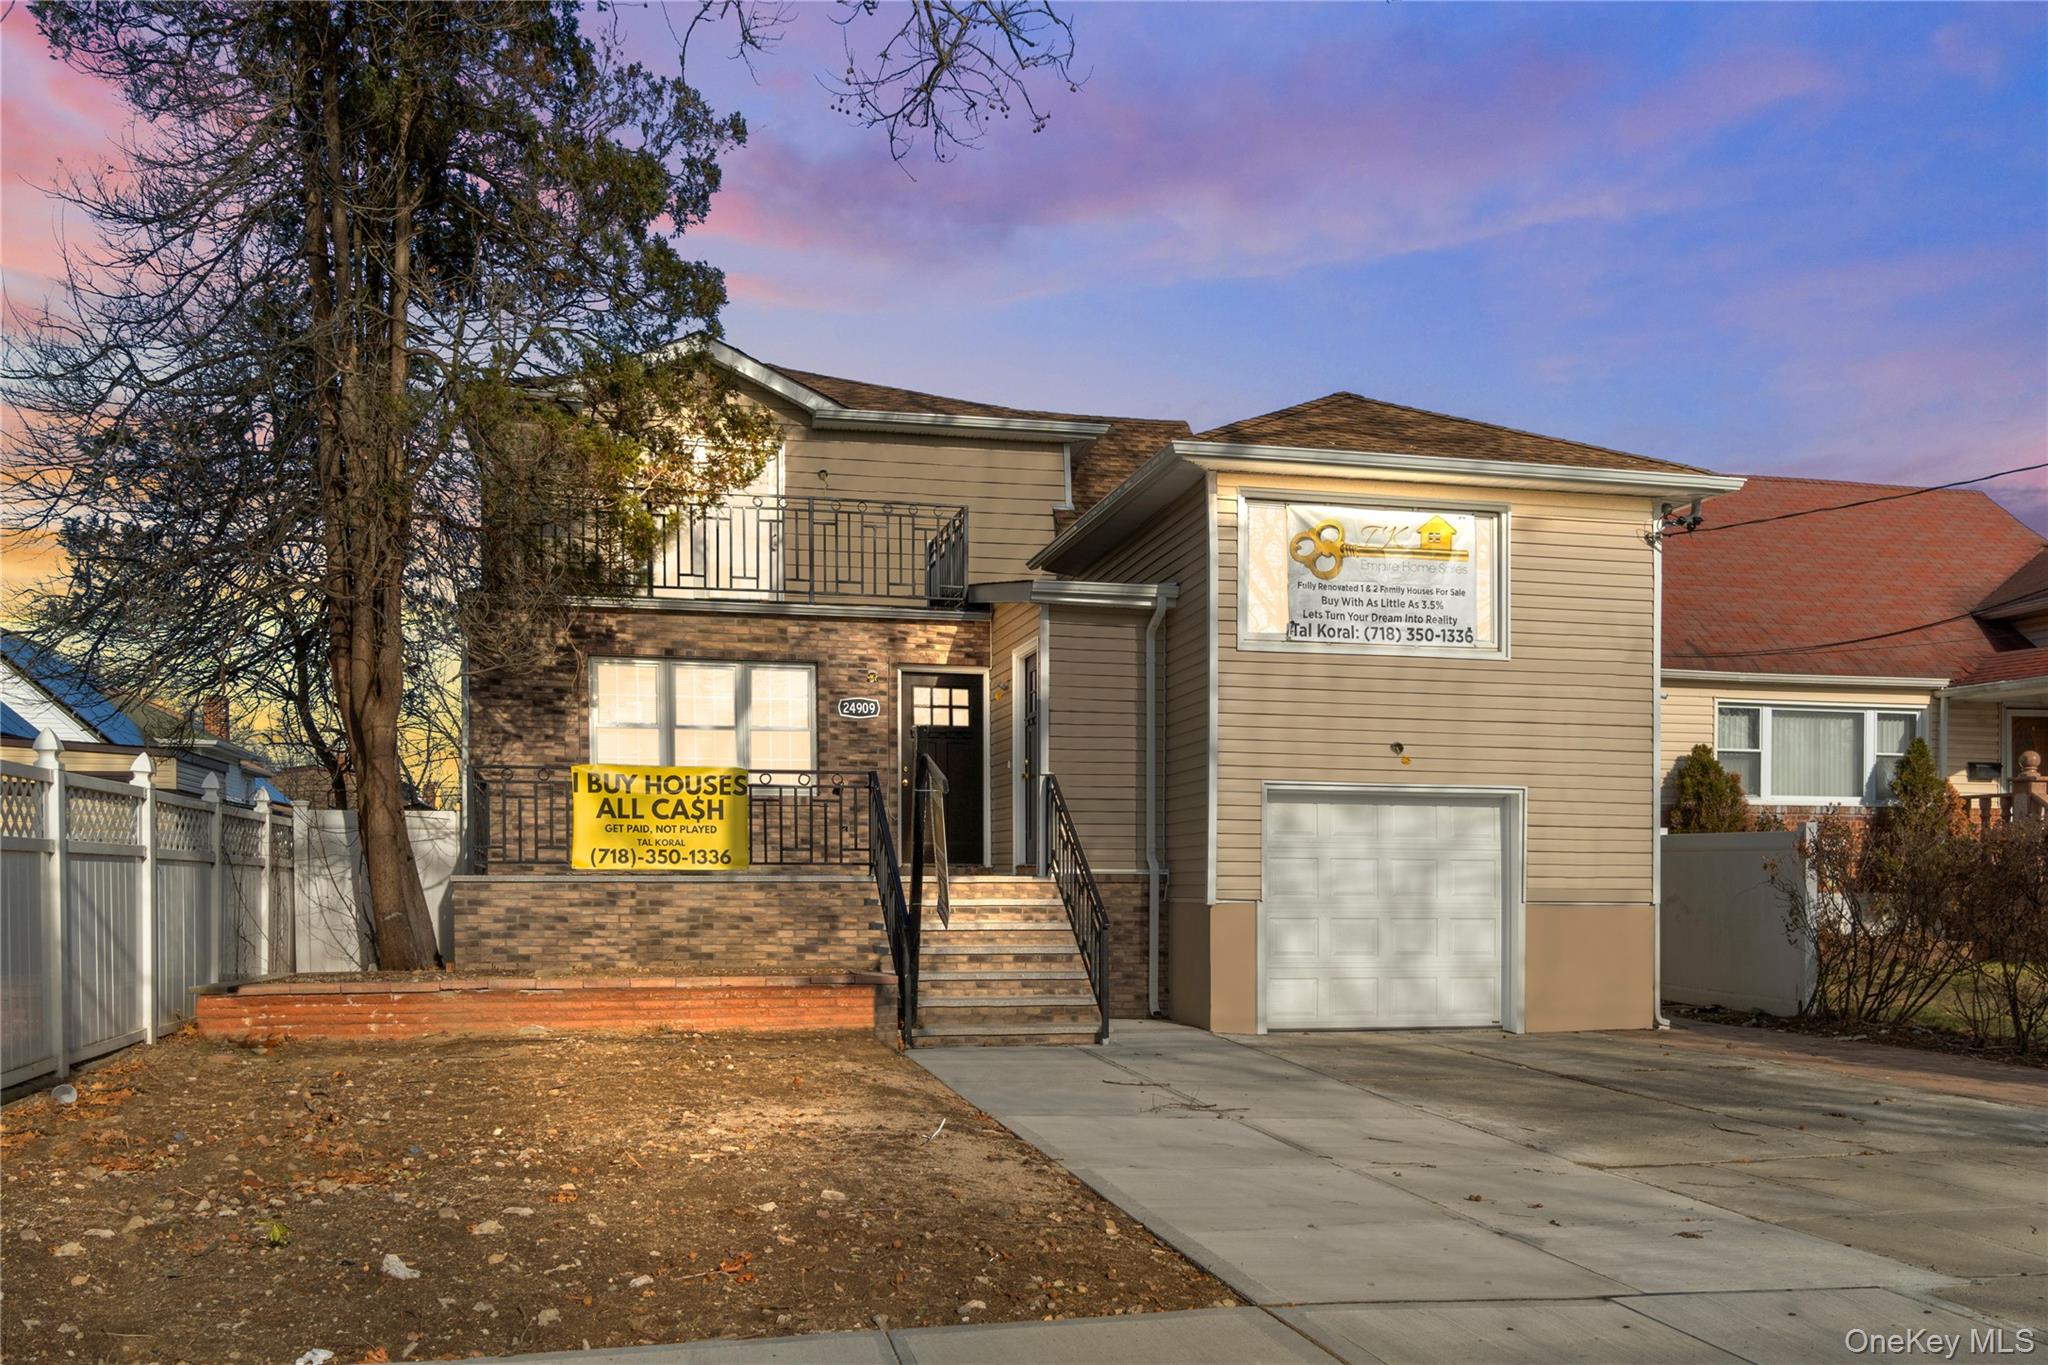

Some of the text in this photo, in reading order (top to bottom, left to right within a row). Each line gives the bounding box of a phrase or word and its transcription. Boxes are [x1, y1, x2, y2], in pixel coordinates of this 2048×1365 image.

[1361, 560, 1400, 573] Empire
[1402, 561, 1437, 573] Home
[1297, 581, 1316, 591] Fully
[1318, 583, 1359, 592] Renovated
[1380, 585, 1405, 595] Family
[1406, 587, 1434, 595] Houses
[1450, 588, 1466, 596] Sale
[1321, 595, 1444, 609] Buy With As Little As 3.5%
[1302, 609, 1458, 626] Lets Turn Your Dream Into Reality
[1293, 622, 1474, 643] Tal Koral: (718) 350-1336
[843, 702, 876, 714] 24909
[573, 772, 747, 796] I BUY HOUSES
[596, 796, 724, 823] ALL CA$H
[605, 824, 717, 834] GET PAID, NOT PLAYED
[637, 838, 685, 847] TAL KORAL
[590, 848, 732, 868] (718)-350-1336
